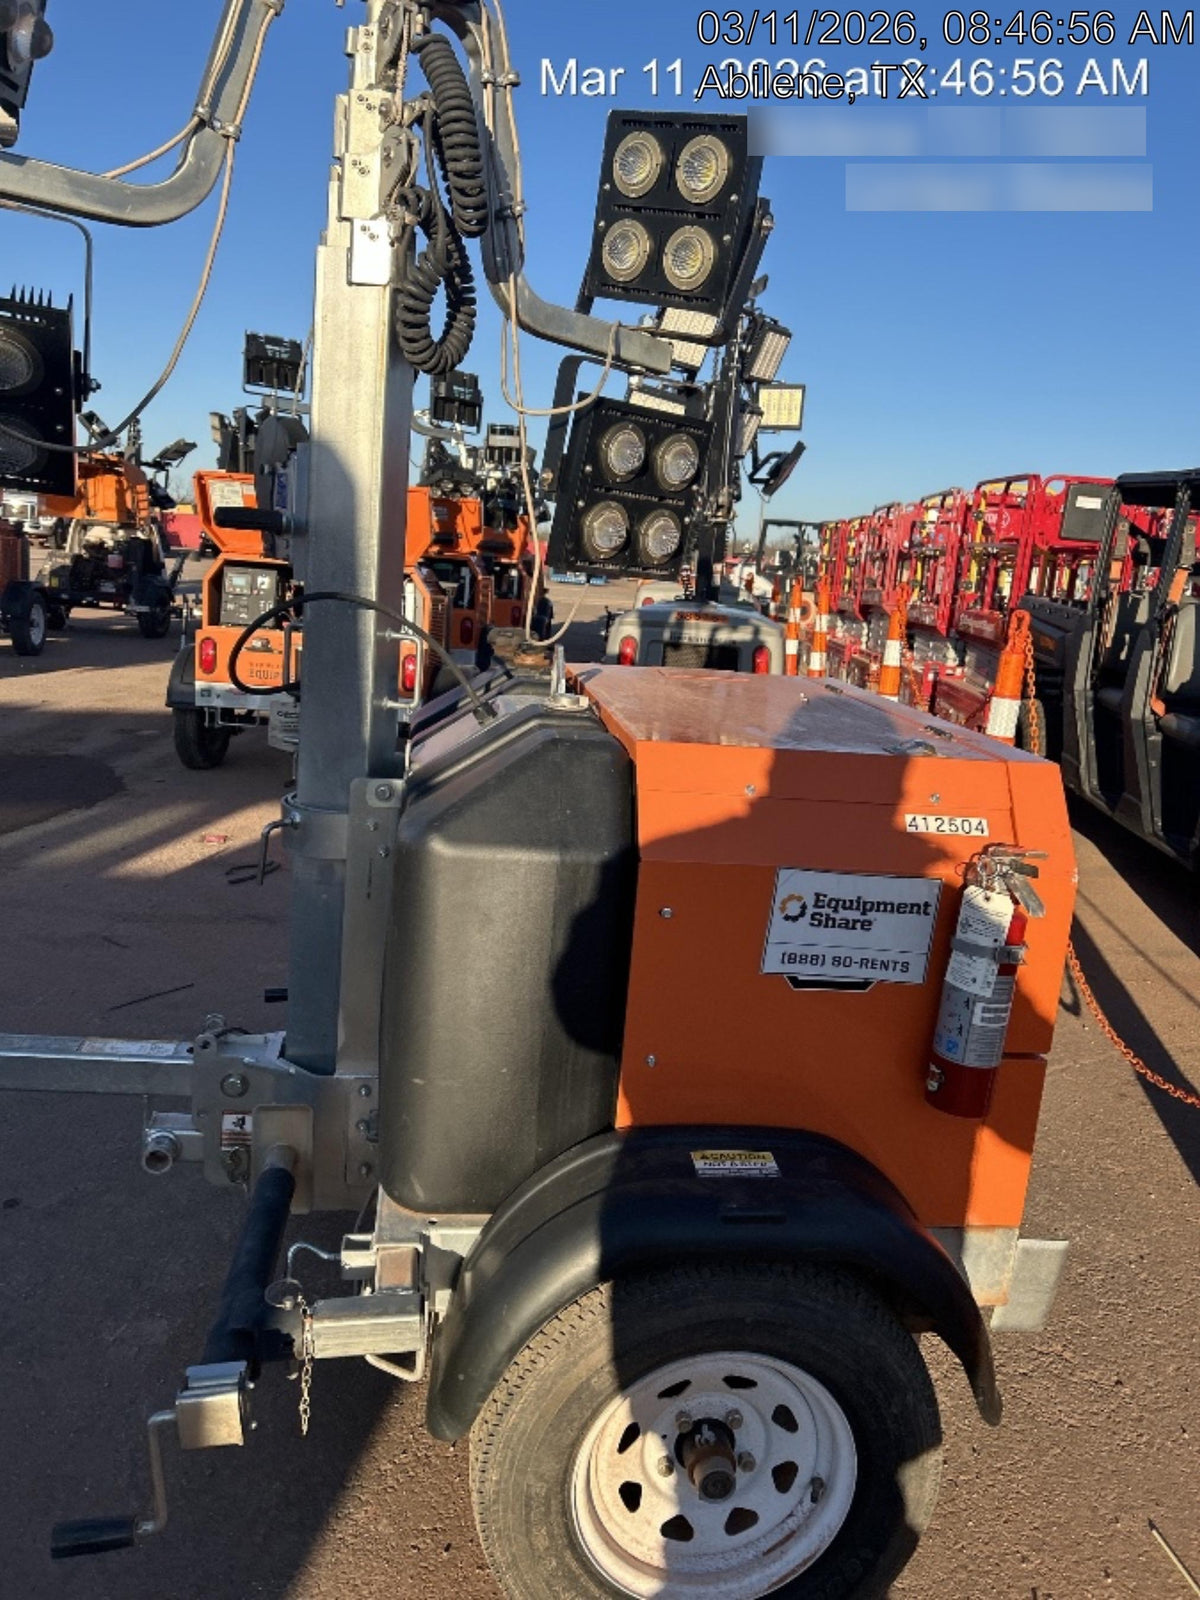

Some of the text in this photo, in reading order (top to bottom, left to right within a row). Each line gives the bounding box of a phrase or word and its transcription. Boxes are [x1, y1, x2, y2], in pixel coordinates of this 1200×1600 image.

[908, 816, 986, 835] 412504
[811, 892, 933, 917] Equipment
[808, 911, 875, 932] Share
[831, 956, 911, 973] 80-RENTS
